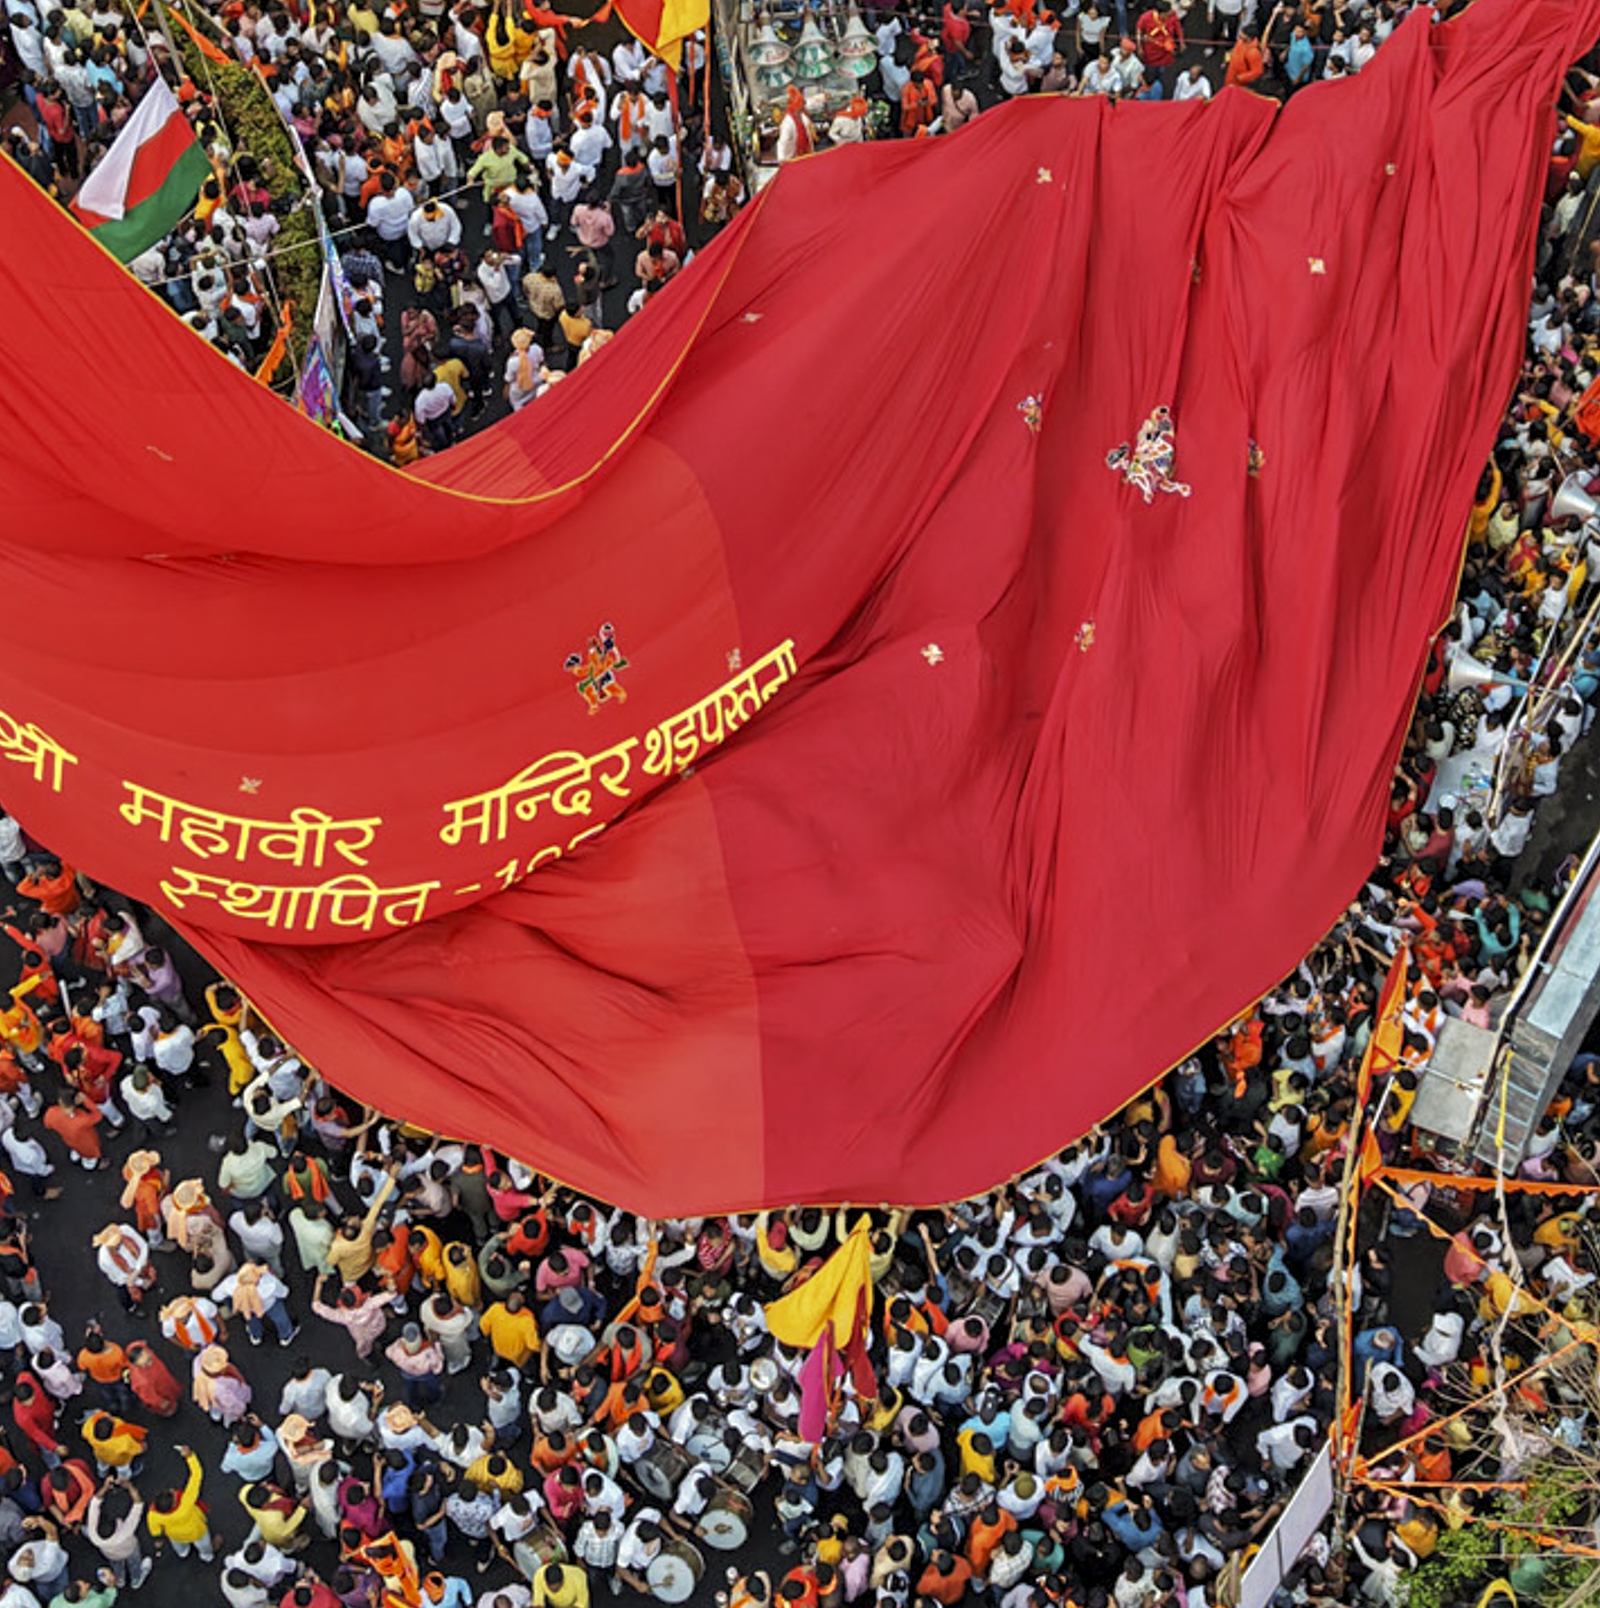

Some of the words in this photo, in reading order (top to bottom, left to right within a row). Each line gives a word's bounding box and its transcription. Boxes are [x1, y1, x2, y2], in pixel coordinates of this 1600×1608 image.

[120, 779, 383, 869] महावीर
[439, 736, 641, 848] मन्दिर
[160, 866, 442, 933] स्थापित
